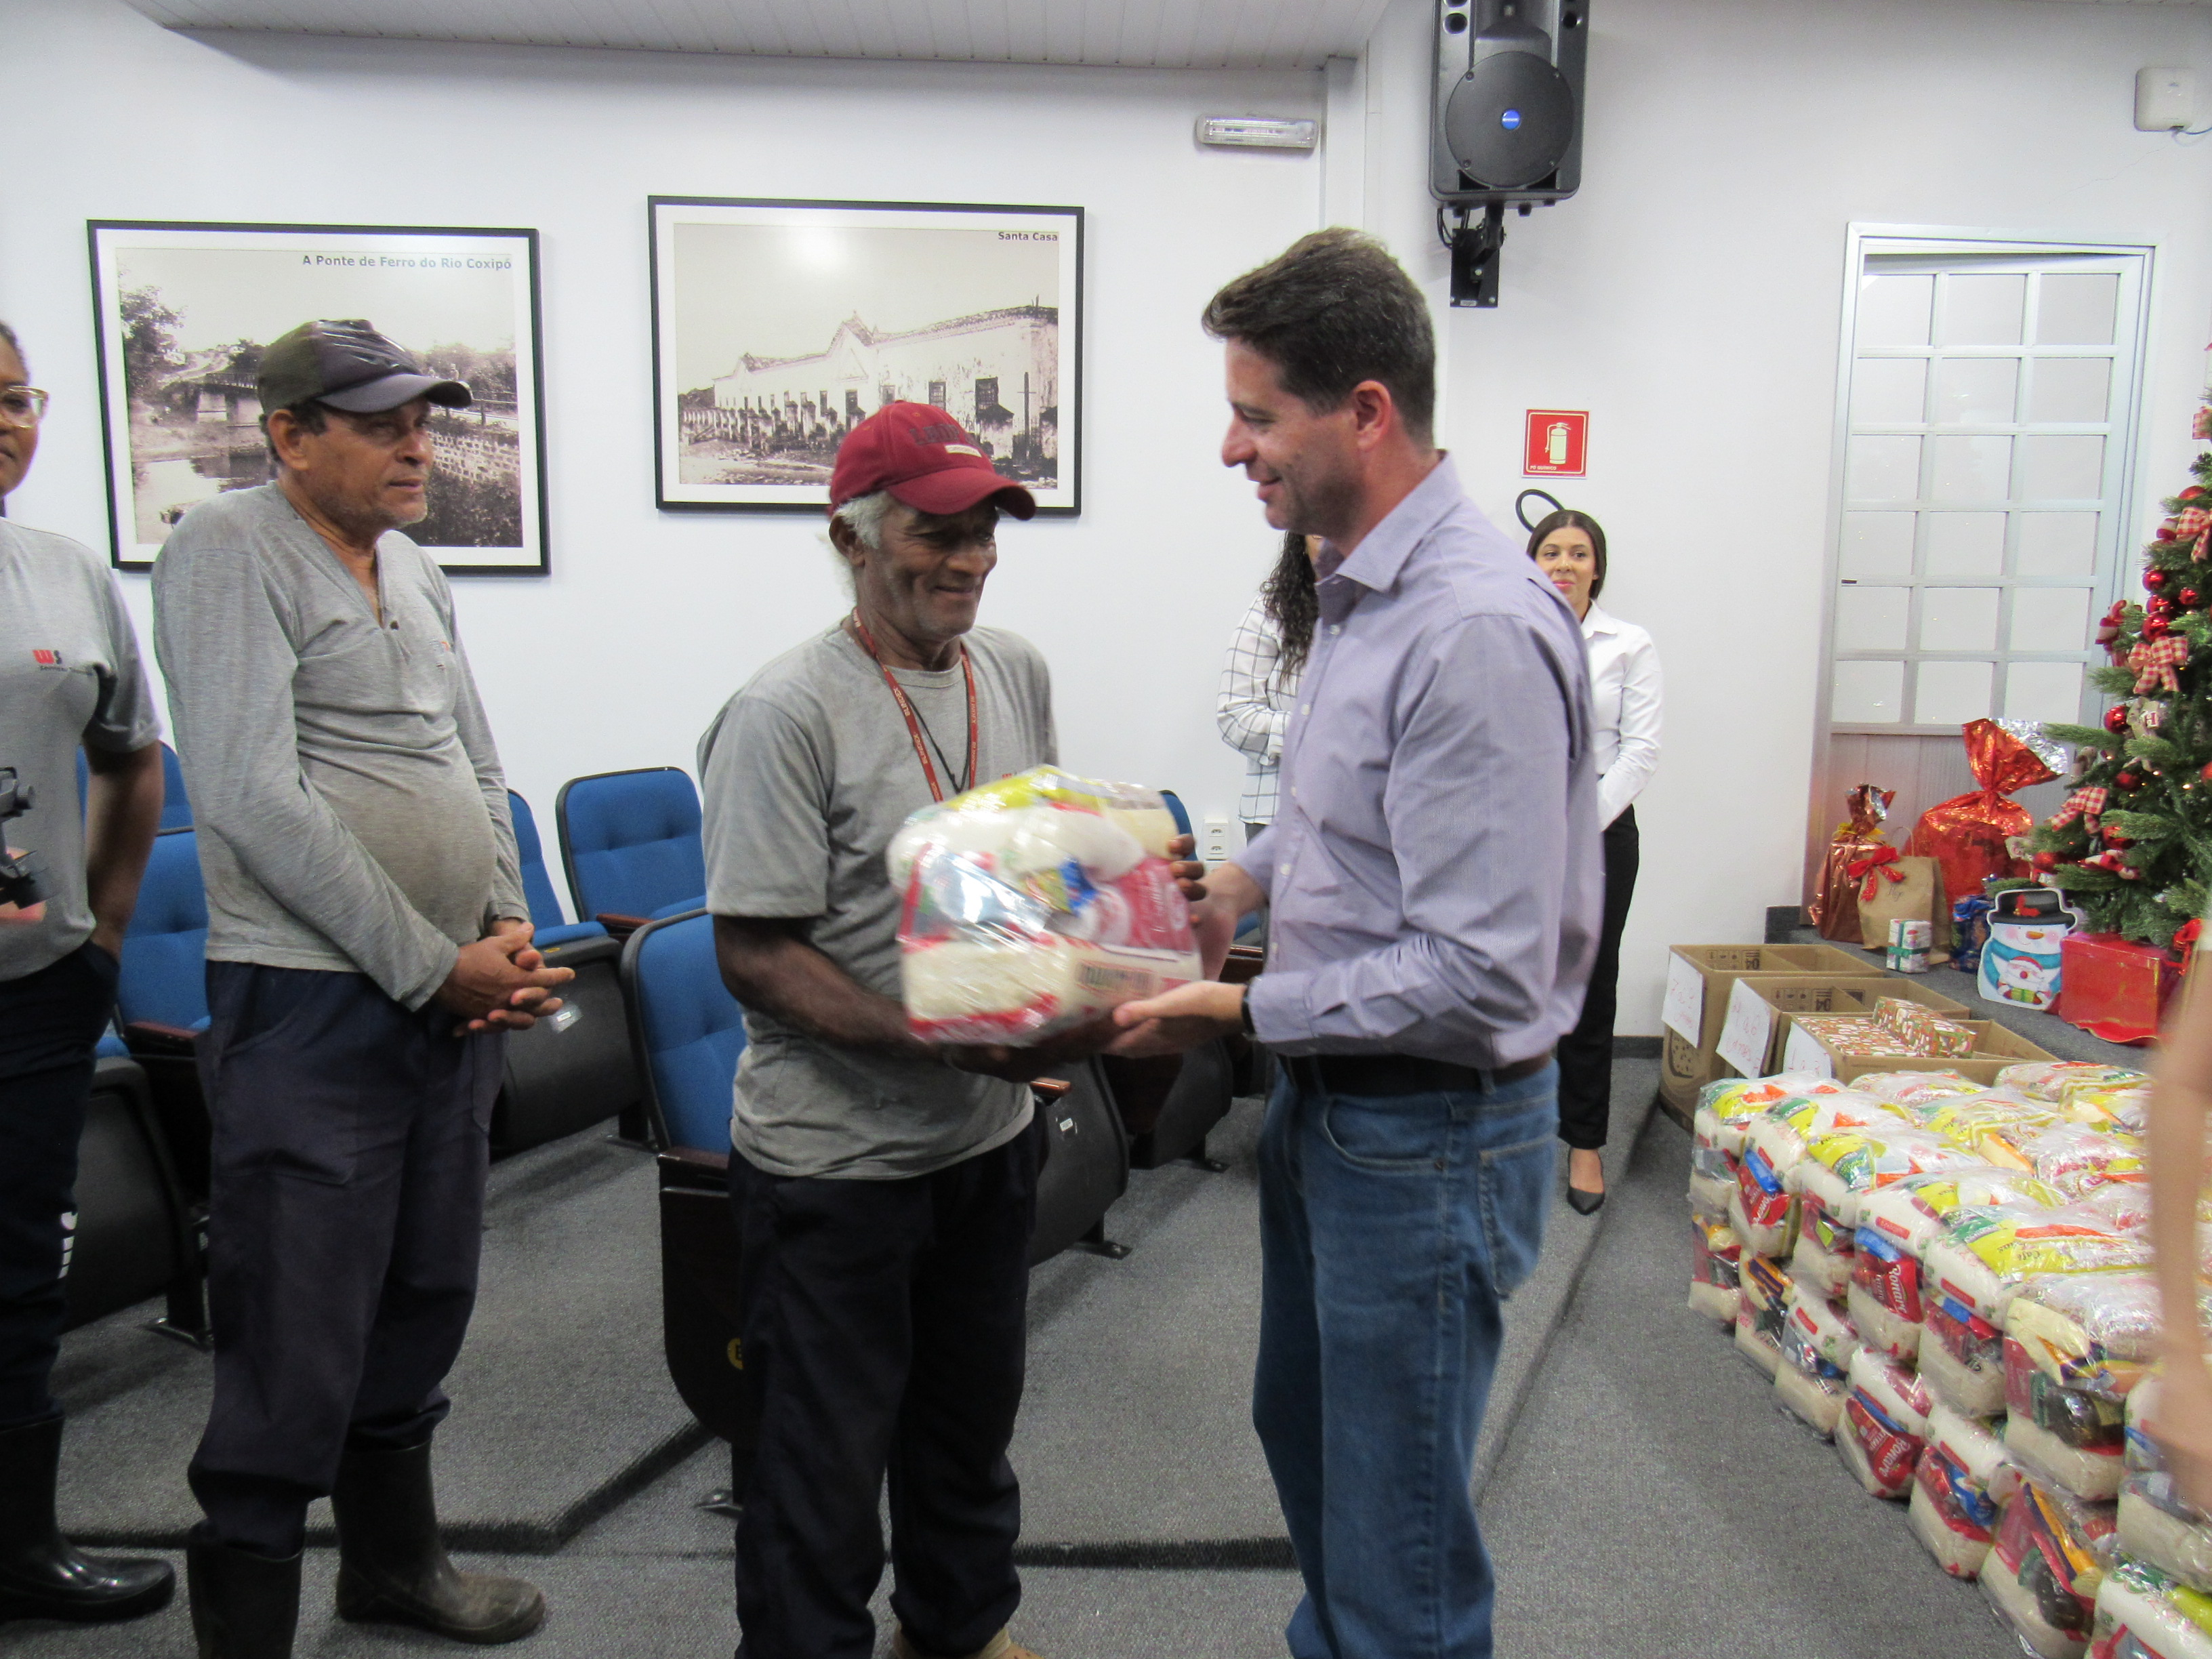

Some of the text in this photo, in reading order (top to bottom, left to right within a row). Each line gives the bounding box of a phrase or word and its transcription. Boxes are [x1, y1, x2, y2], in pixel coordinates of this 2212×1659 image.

[998, 232, 1057, 241] Santa Casa
[303, 255, 511, 270] A Ponte de Ferro do Rio Coxipó
[893, 687, 911, 716] BLINDEX
[913, 733, 928, 764] BLINDEX
[1879, 1437, 1911, 1477] Bonare
